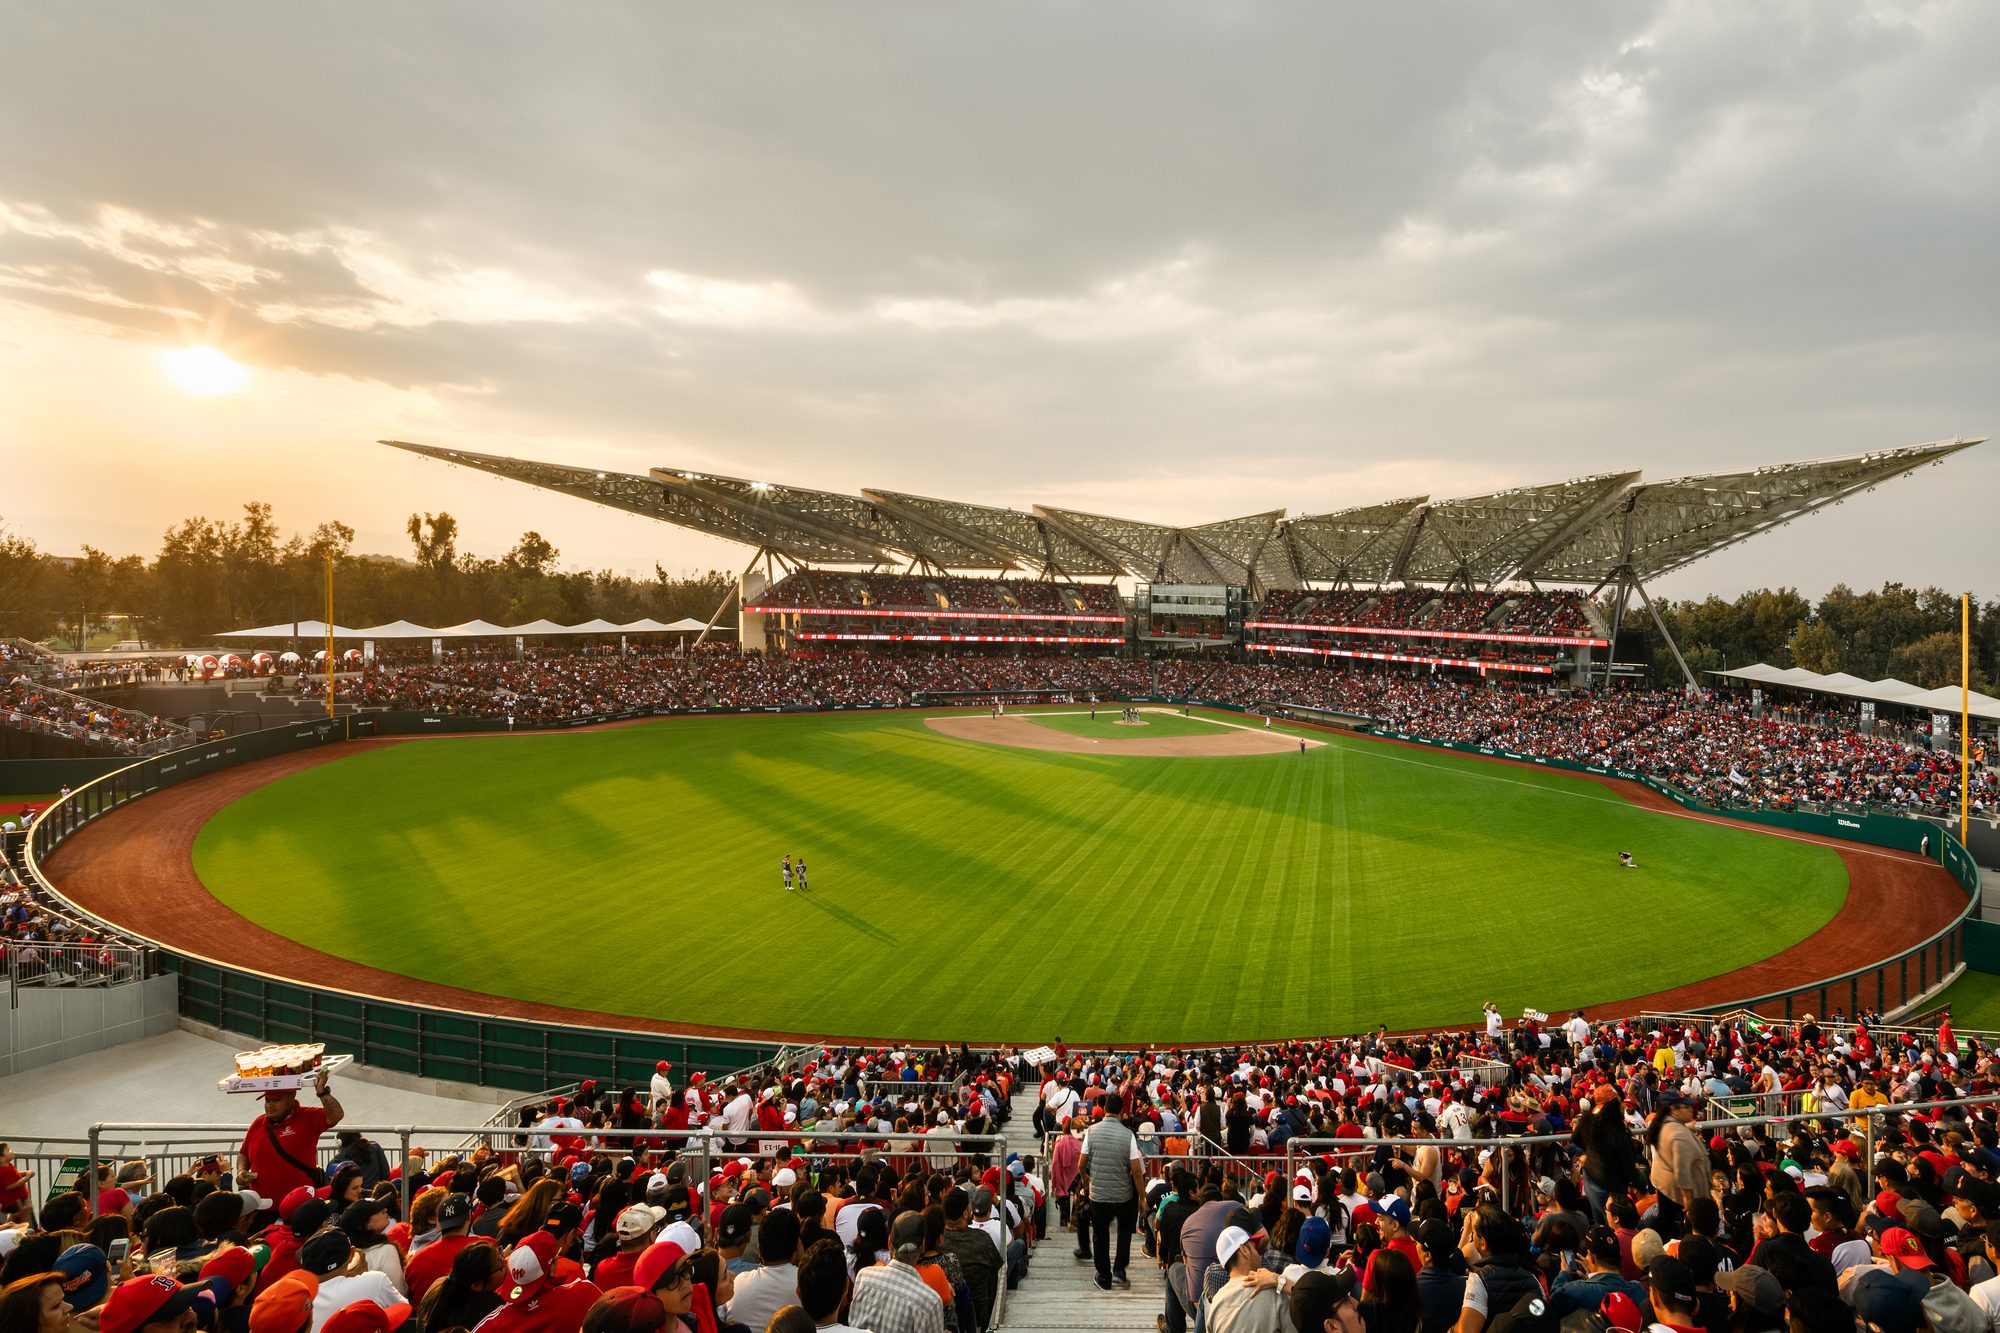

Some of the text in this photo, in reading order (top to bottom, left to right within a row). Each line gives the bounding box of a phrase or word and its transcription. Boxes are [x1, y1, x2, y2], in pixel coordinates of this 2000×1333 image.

[1862, 703, 1875, 711] B8
[1934, 715, 1949, 724] B9
[1617, 770, 1636, 779] Kivac
[1837, 818, 1860, 828] Wilson
[1455, 1112, 1468, 1126] 13
[151, 1275, 176, 1291] B
